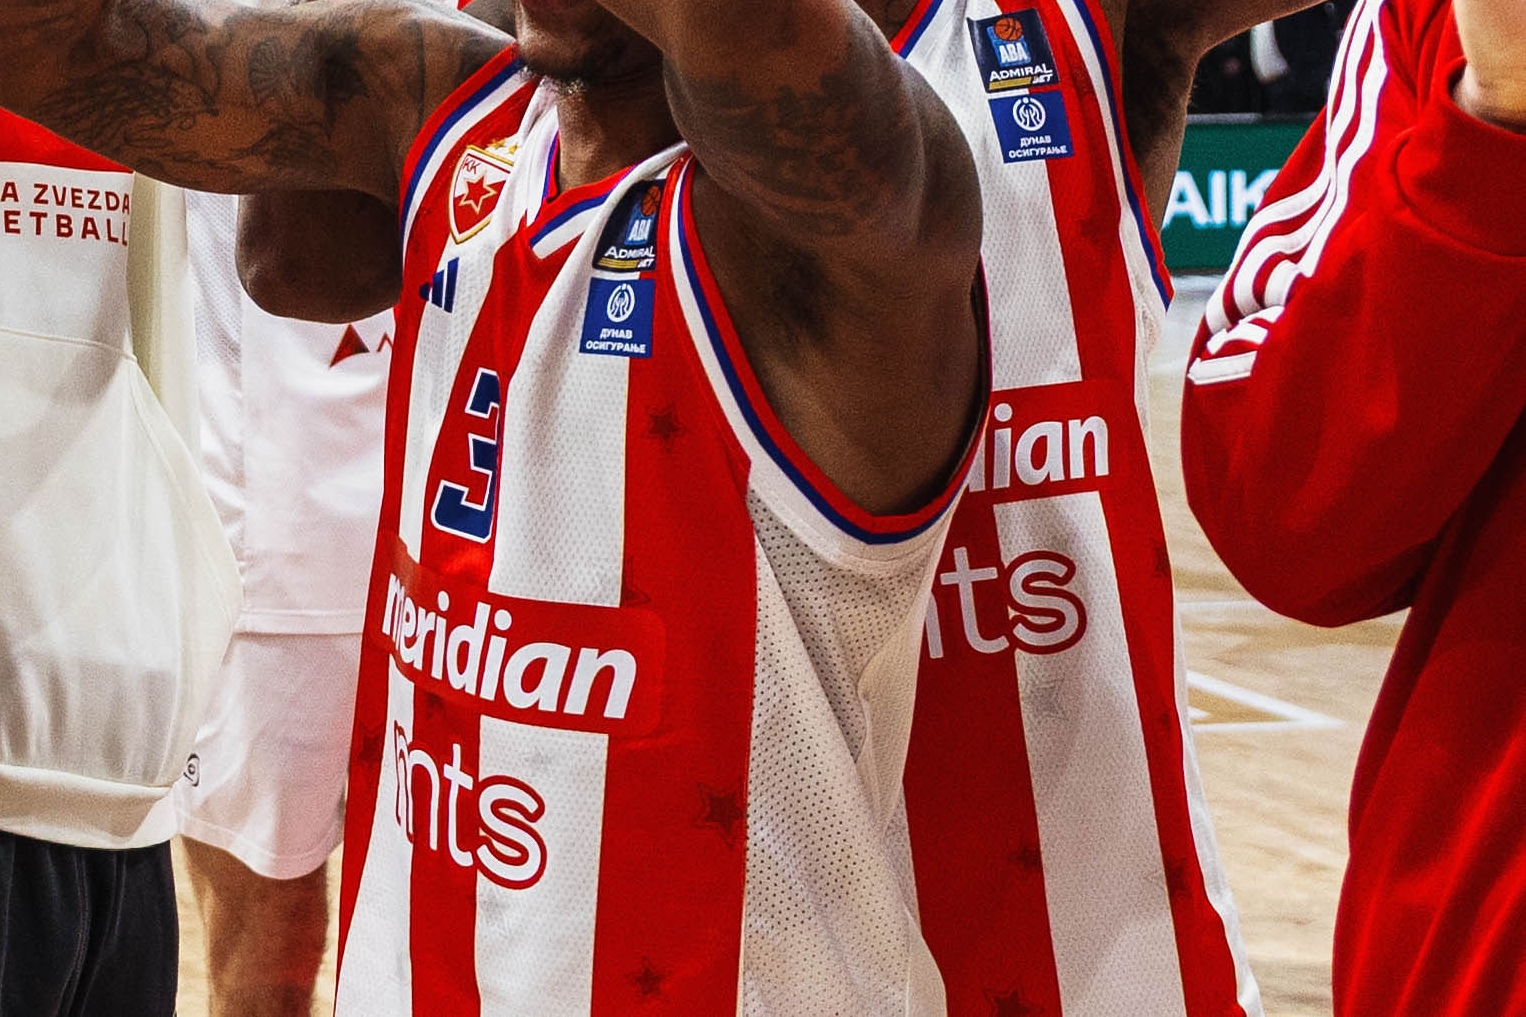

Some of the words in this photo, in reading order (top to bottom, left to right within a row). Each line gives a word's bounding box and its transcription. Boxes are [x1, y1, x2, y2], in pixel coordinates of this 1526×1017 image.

[999, 42, 1028, 64] ABA
[989, 63, 1054, 82] ADMIRAL
[1020, 135, 1052, 150] ДУНАВ
[1008, 145, 1069, 160] ОСИГУРАЊЕ
[32, 183, 130, 215] ZVEZDA
[1162, 169, 1281, 229] AIK
[604, 245, 656, 260] ADMIRAL
[600, 328, 633, 340] ДУНАВ
[585, 340, 647, 355] ОСИГУРАЊЕ
[431, 368, 501, 543] 3
[925, 546, 1088, 655] ts
